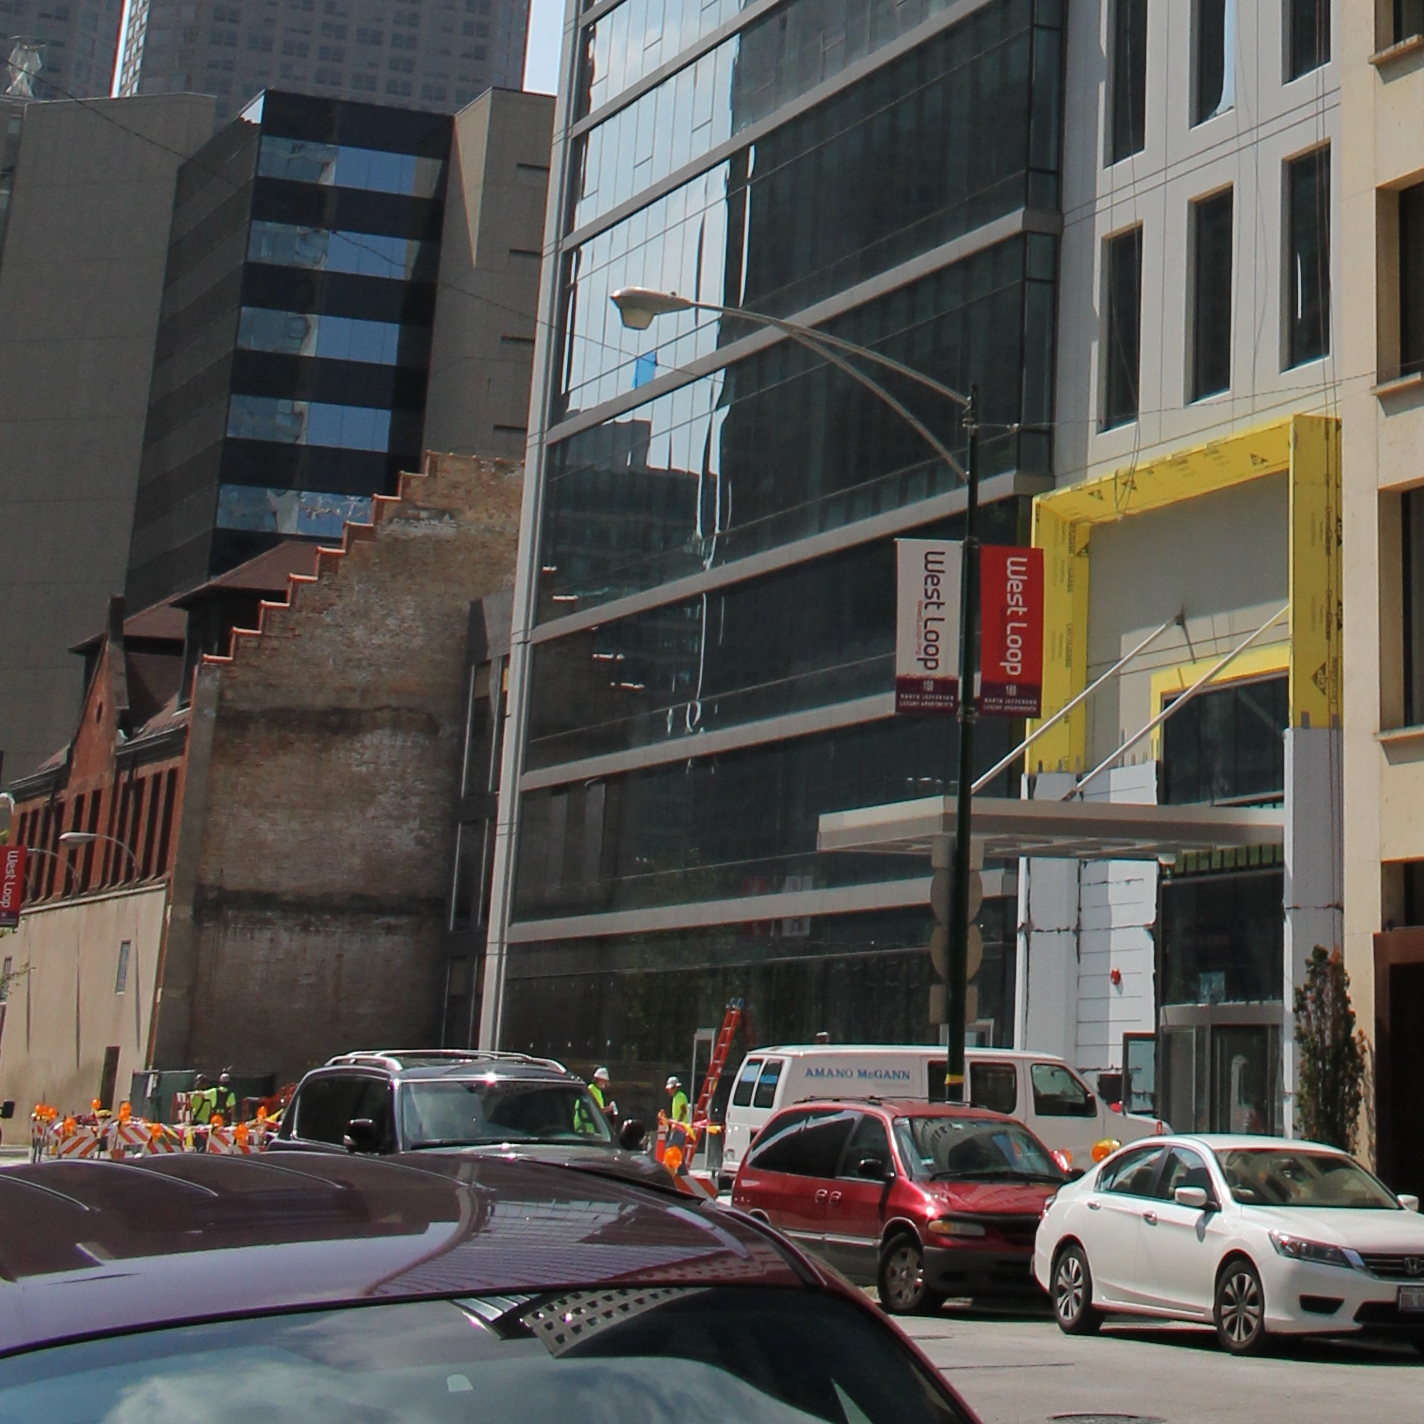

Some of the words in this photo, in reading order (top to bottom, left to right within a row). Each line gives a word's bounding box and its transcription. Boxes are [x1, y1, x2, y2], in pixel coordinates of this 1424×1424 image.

[924, 551, 946, 610] West
[1006, 556, 1028, 616] West
[917, 617, 945, 671] Loop
[1000, 622, 1028, 676] Loop
[5, 850, 19, 880] West
[0, 882, 16, 908] Loop
[805, 1067, 853, 1078] AMANO
[857, 1069, 910, 1080] McGANN
